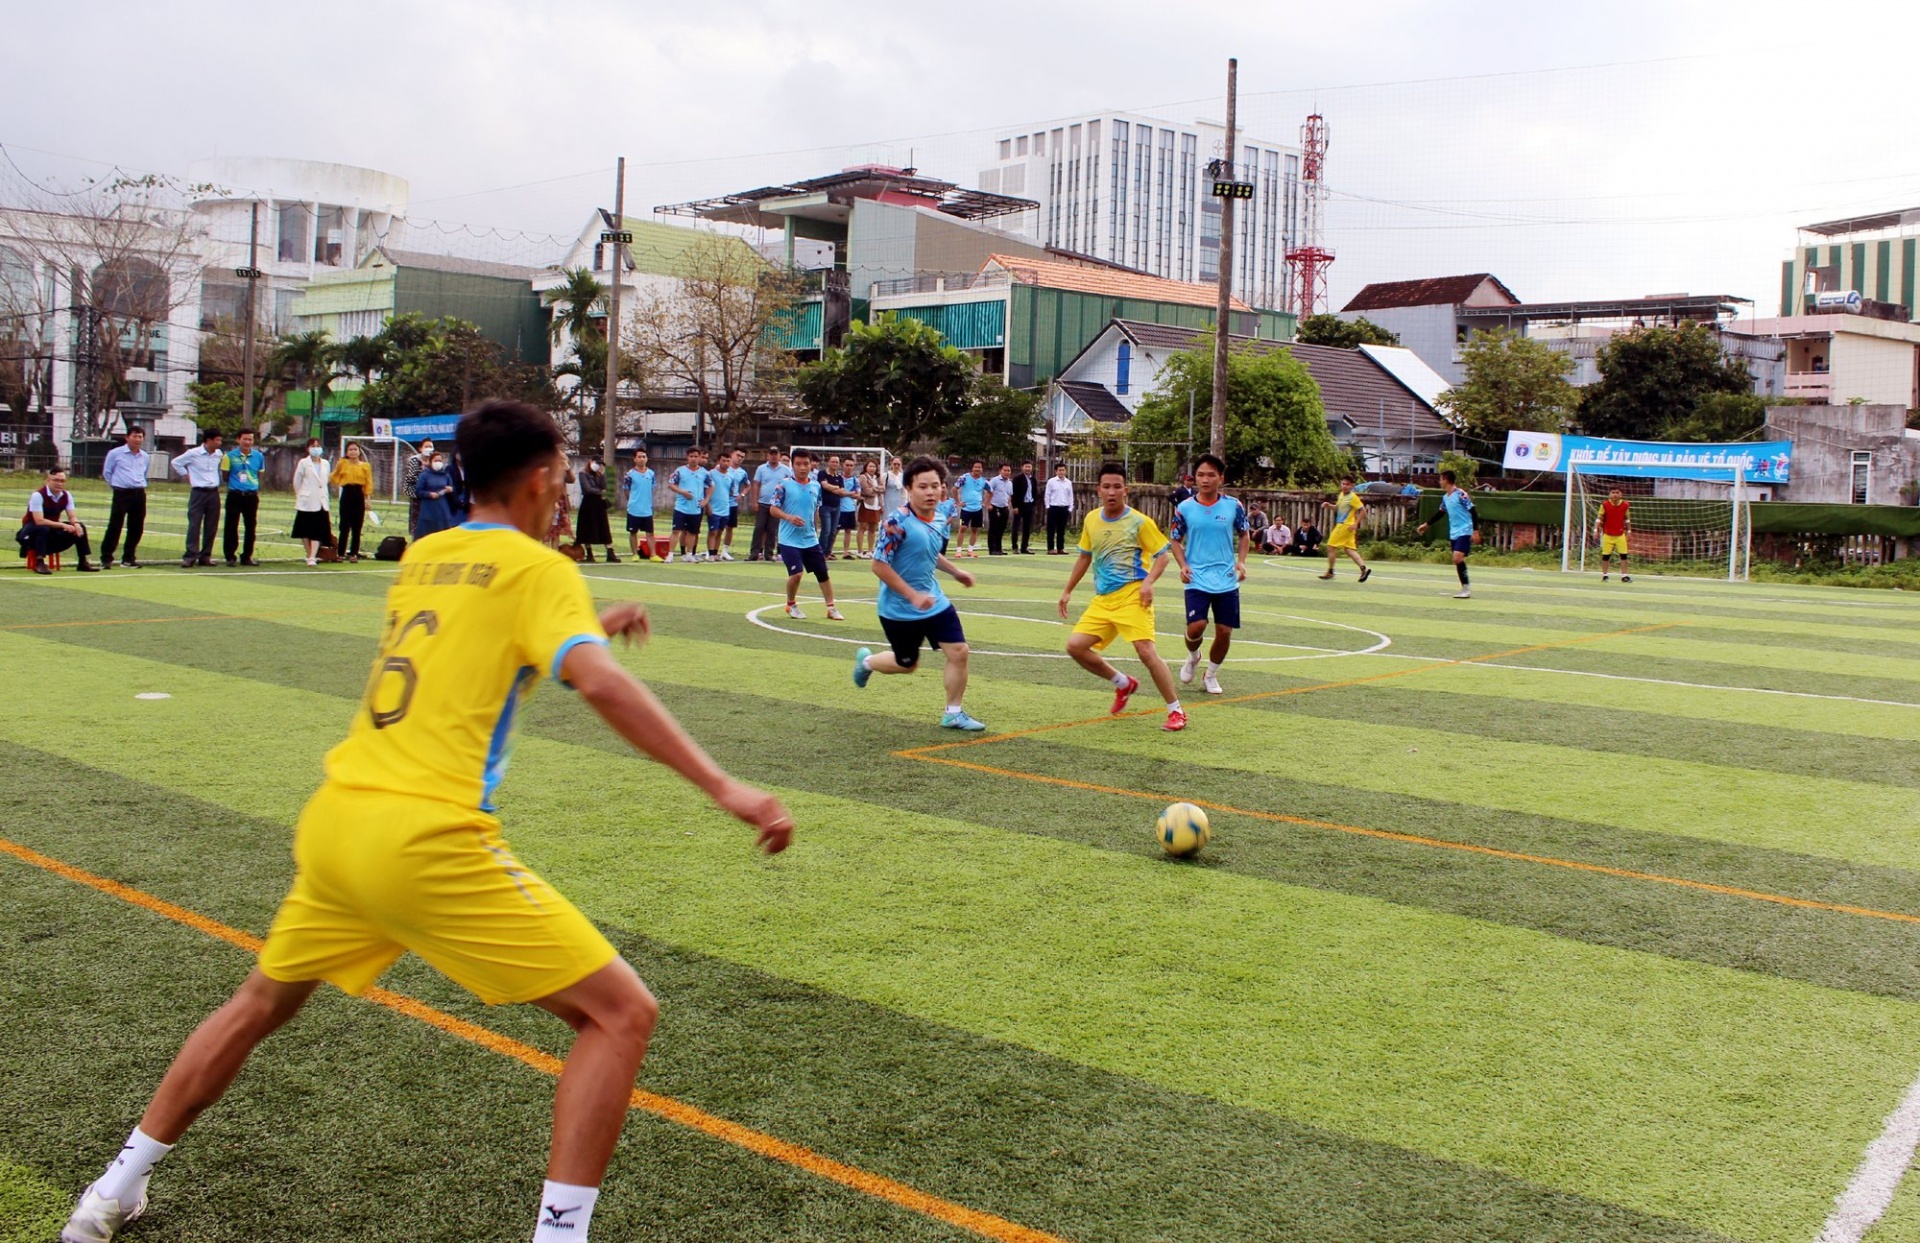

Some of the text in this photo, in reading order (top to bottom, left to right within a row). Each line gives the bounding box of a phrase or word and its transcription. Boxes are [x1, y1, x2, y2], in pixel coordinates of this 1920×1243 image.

[1569, 444, 1595, 461] KHỎE
[1612, 449, 1631, 462] XÂY
[1726, 450, 1754, 471] QUỐC
